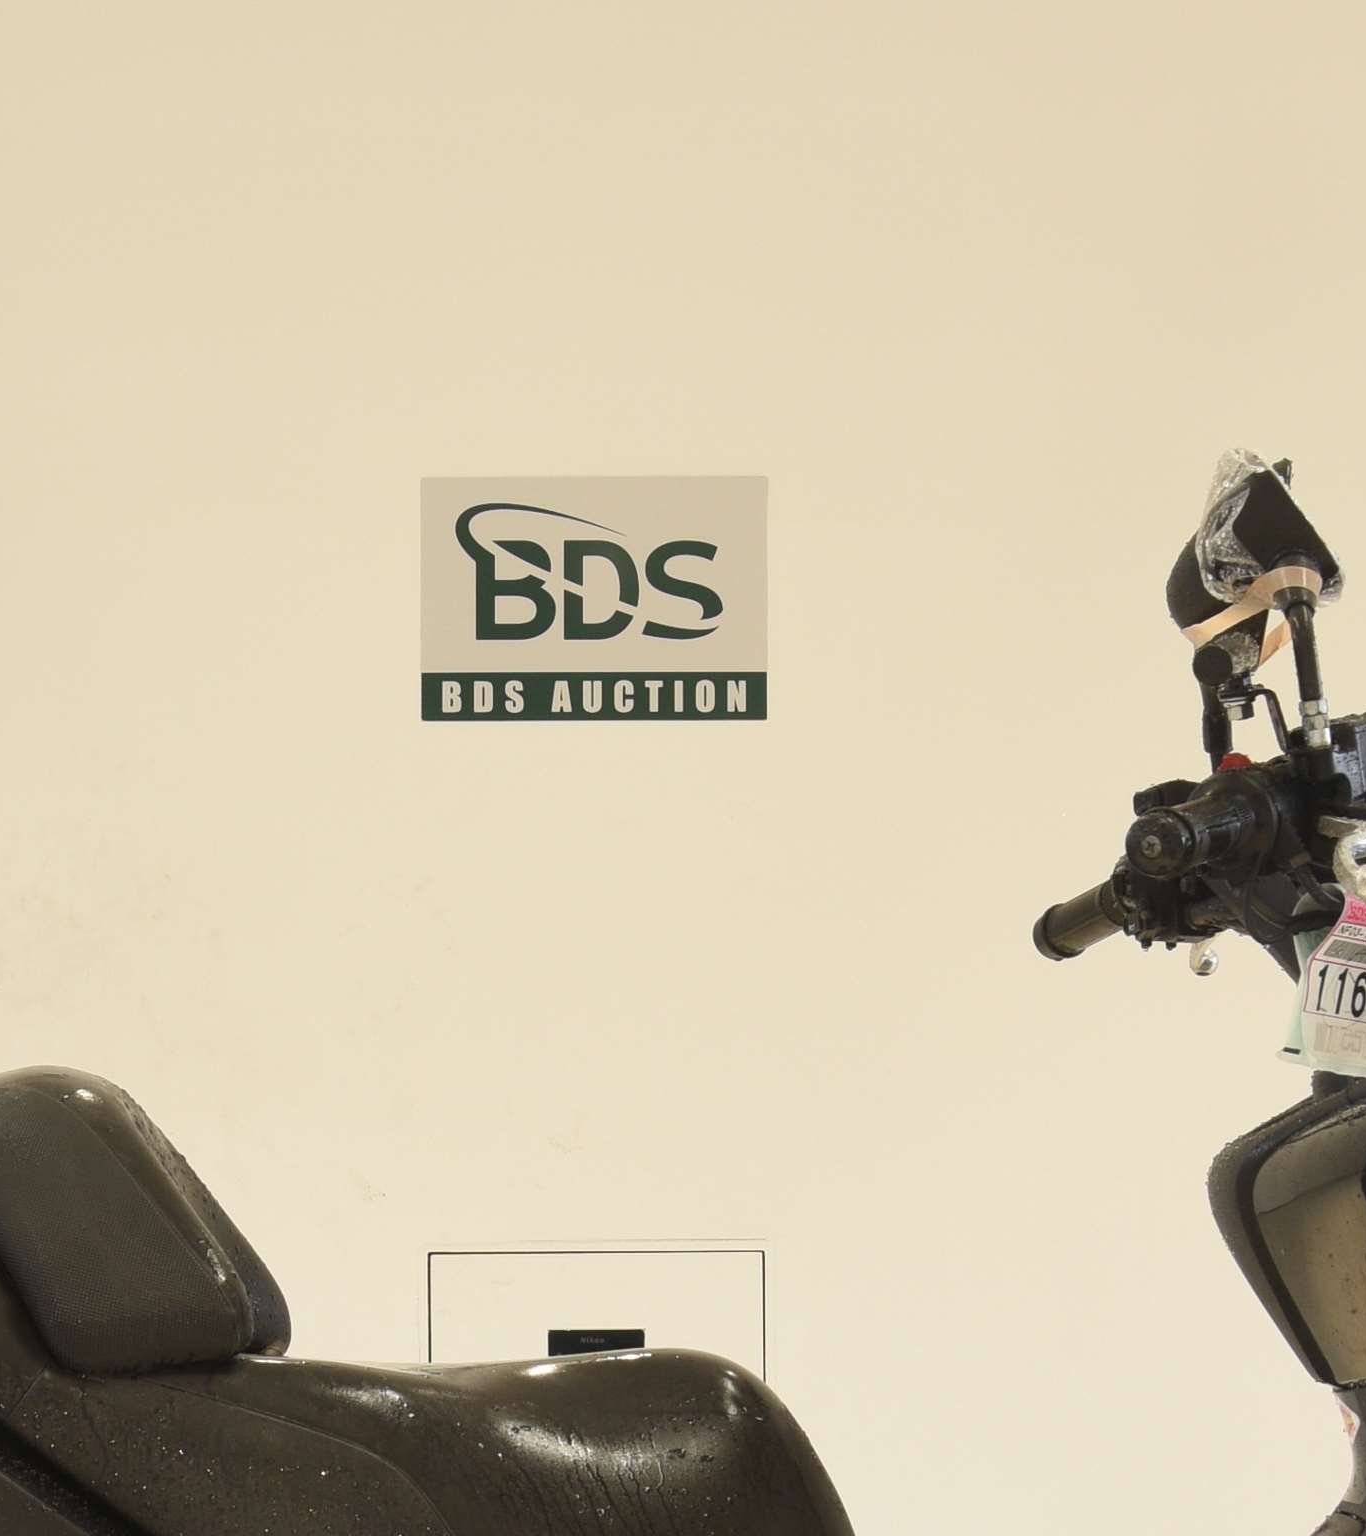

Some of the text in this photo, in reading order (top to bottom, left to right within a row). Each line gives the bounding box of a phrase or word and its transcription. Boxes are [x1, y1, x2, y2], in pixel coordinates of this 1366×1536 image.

[455, 502, 725, 641] BDS
[441, 680, 748, 714] BDS AUCTION
